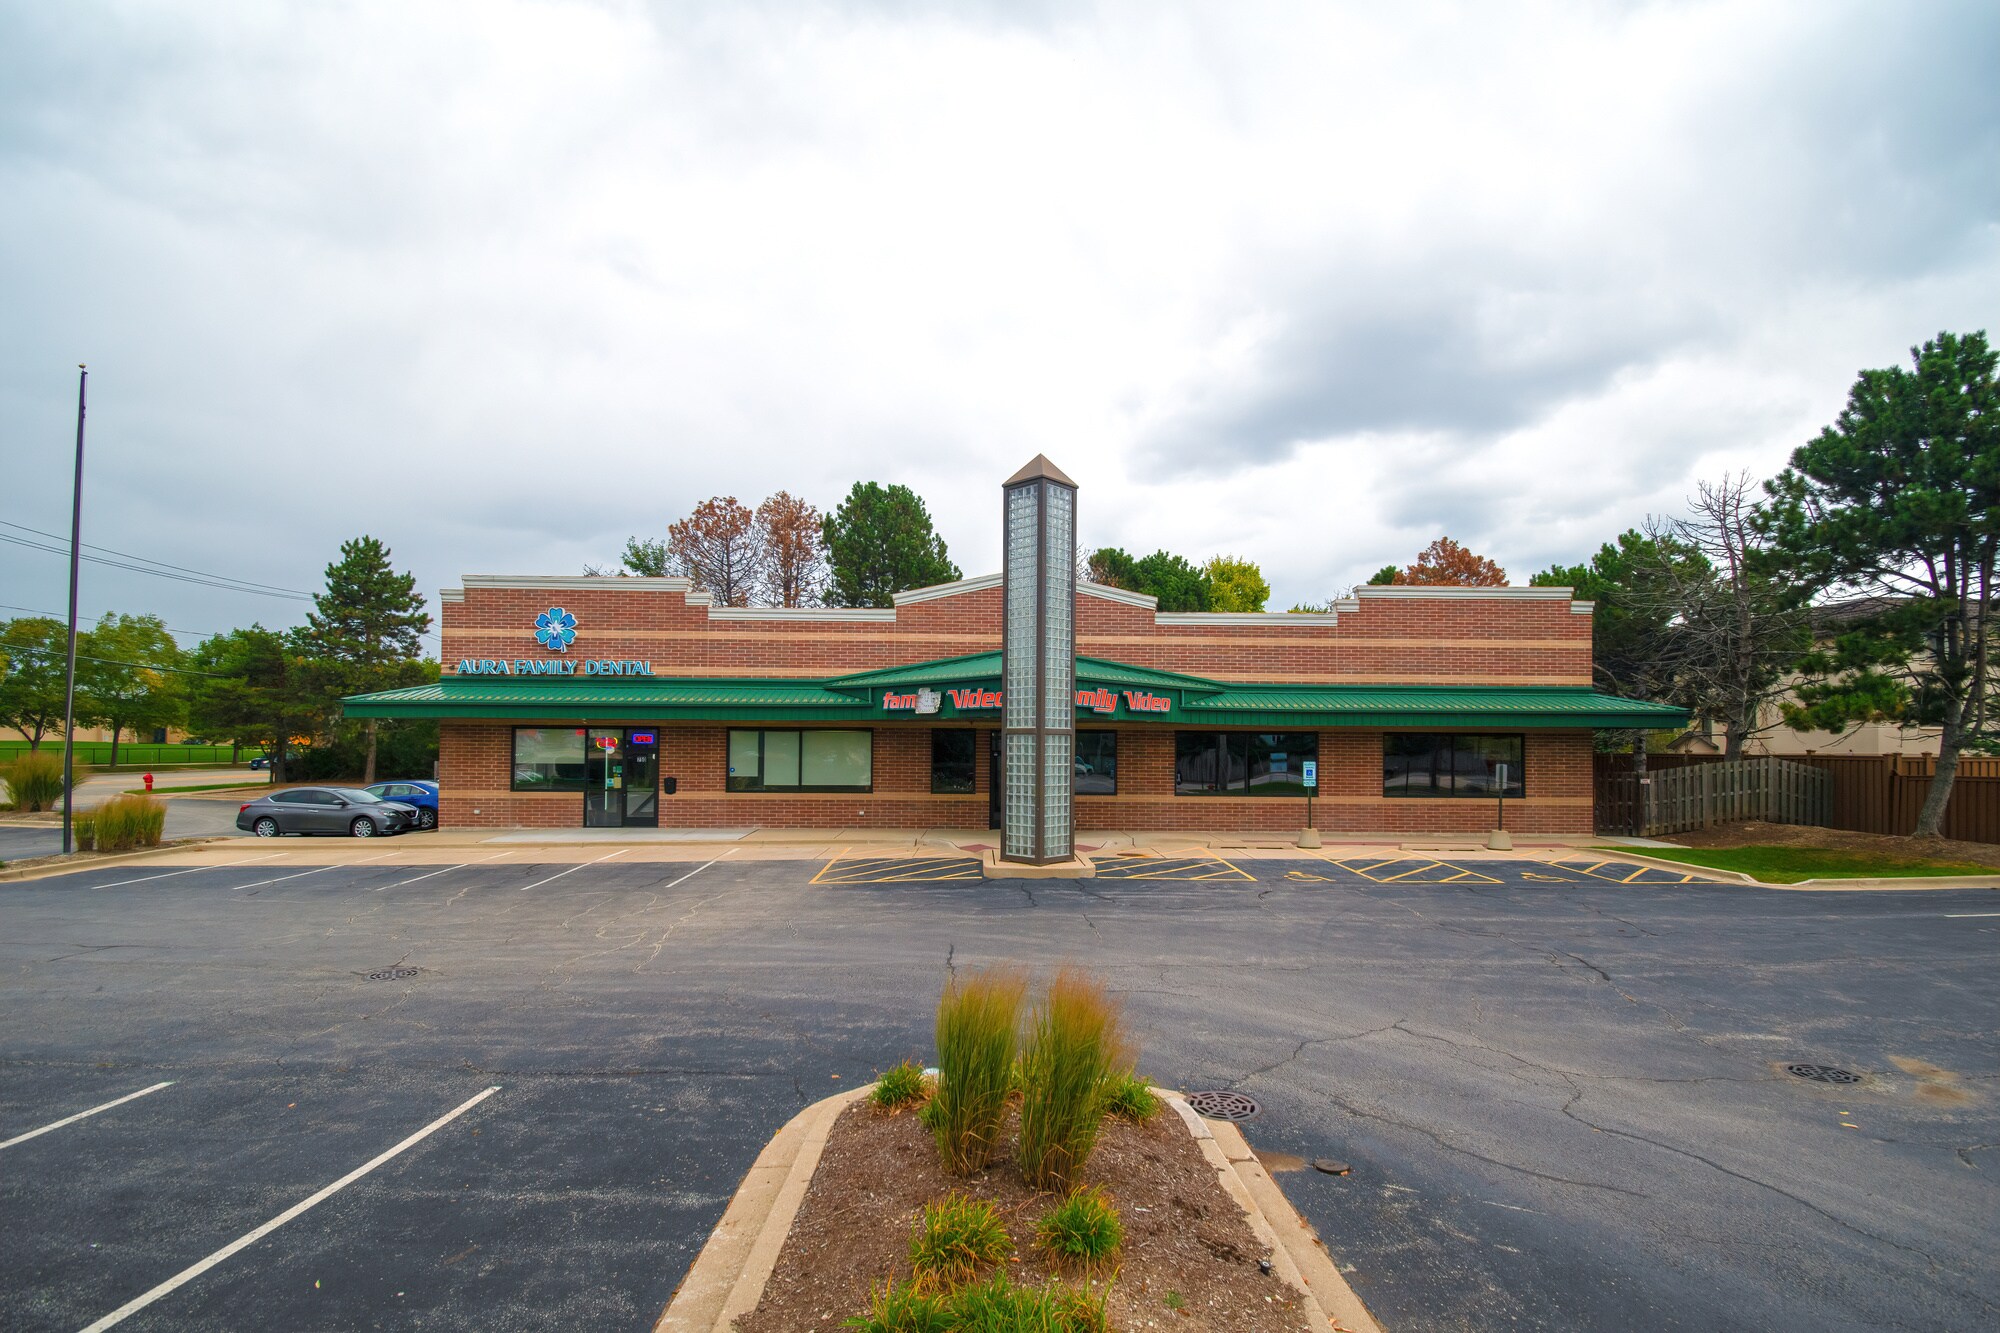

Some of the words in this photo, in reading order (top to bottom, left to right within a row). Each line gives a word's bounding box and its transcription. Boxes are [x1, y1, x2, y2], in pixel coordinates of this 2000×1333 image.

[457, 659, 510, 675] AURA
[513, 660, 577, 675] FAMILY
[585, 660, 655, 675] DENTAL
[1074, 688, 1118, 712] mily
[1123, 690, 1171, 712] Video
